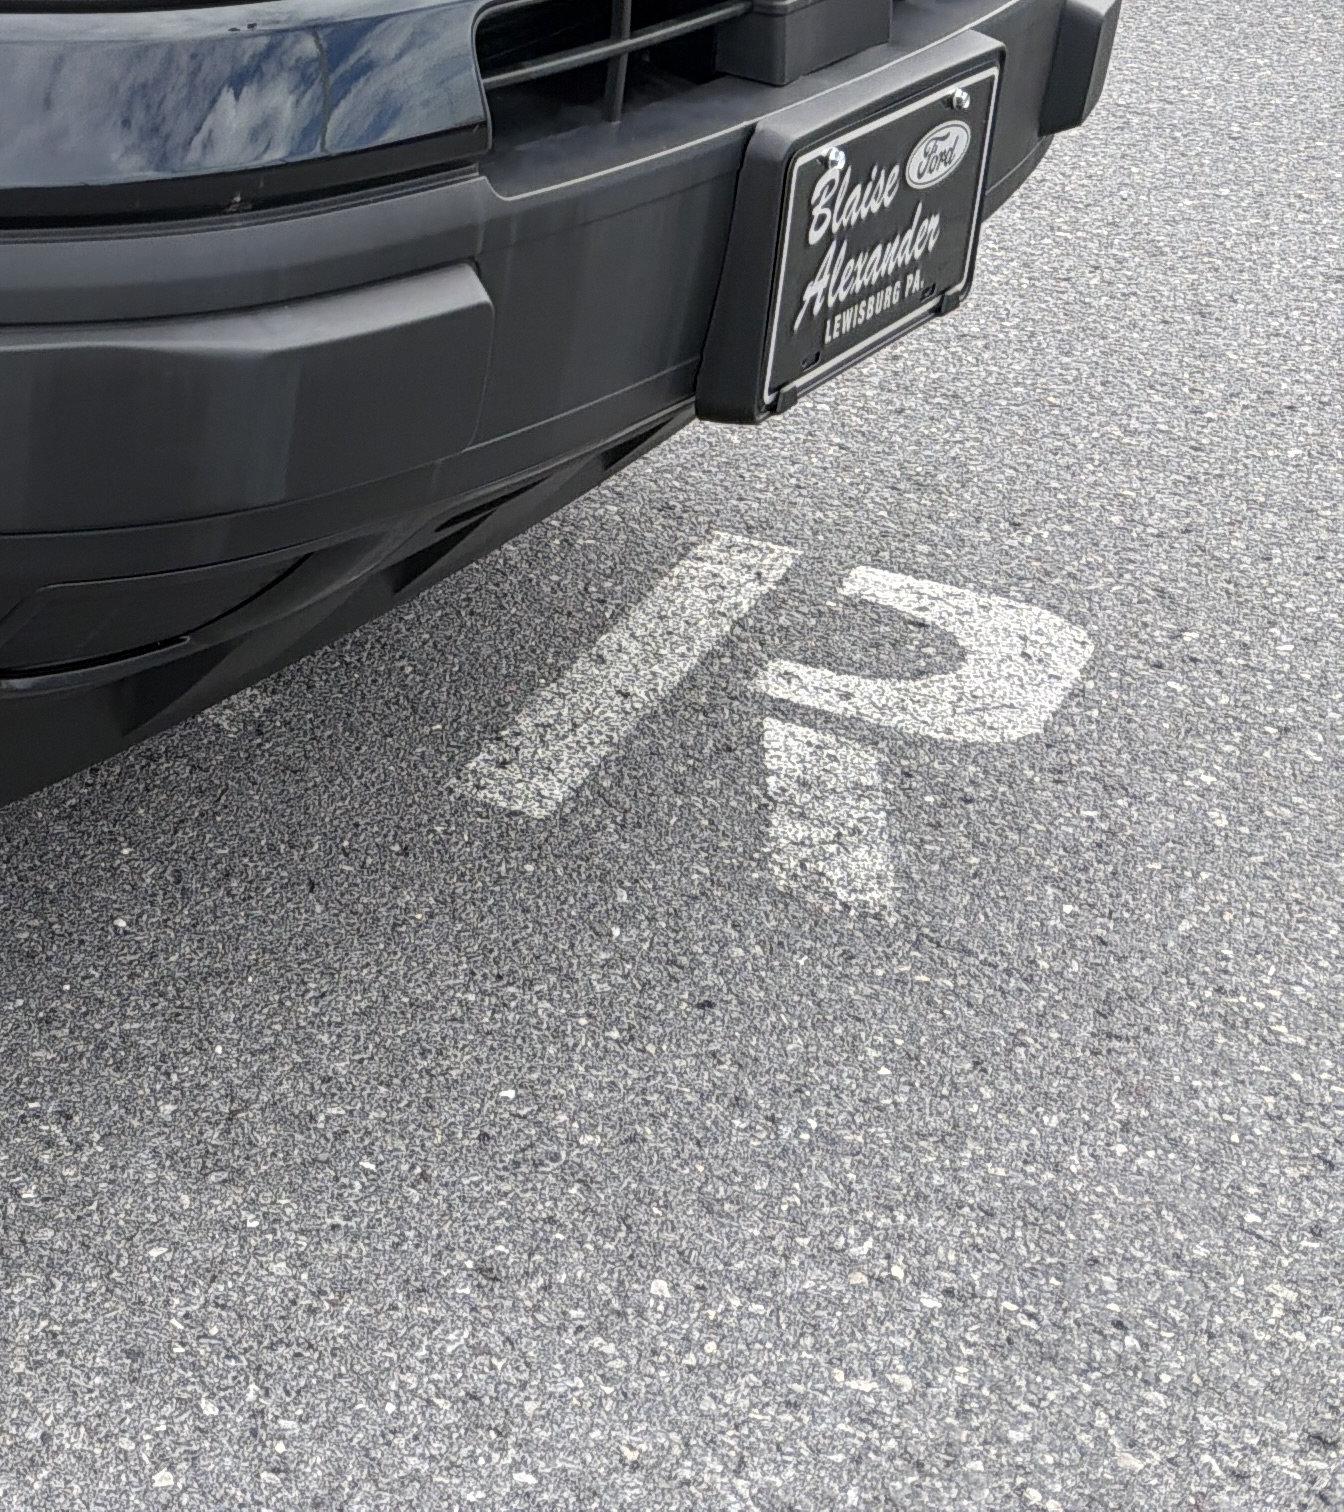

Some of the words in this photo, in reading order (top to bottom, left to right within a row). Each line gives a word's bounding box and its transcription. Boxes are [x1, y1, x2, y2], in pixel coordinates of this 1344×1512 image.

[917, 131, 960, 180] Ford
[808, 163, 900, 245] Blaise
[793, 200, 940, 333] Alexander
[824, 281, 901, 345] LEWISBURG
